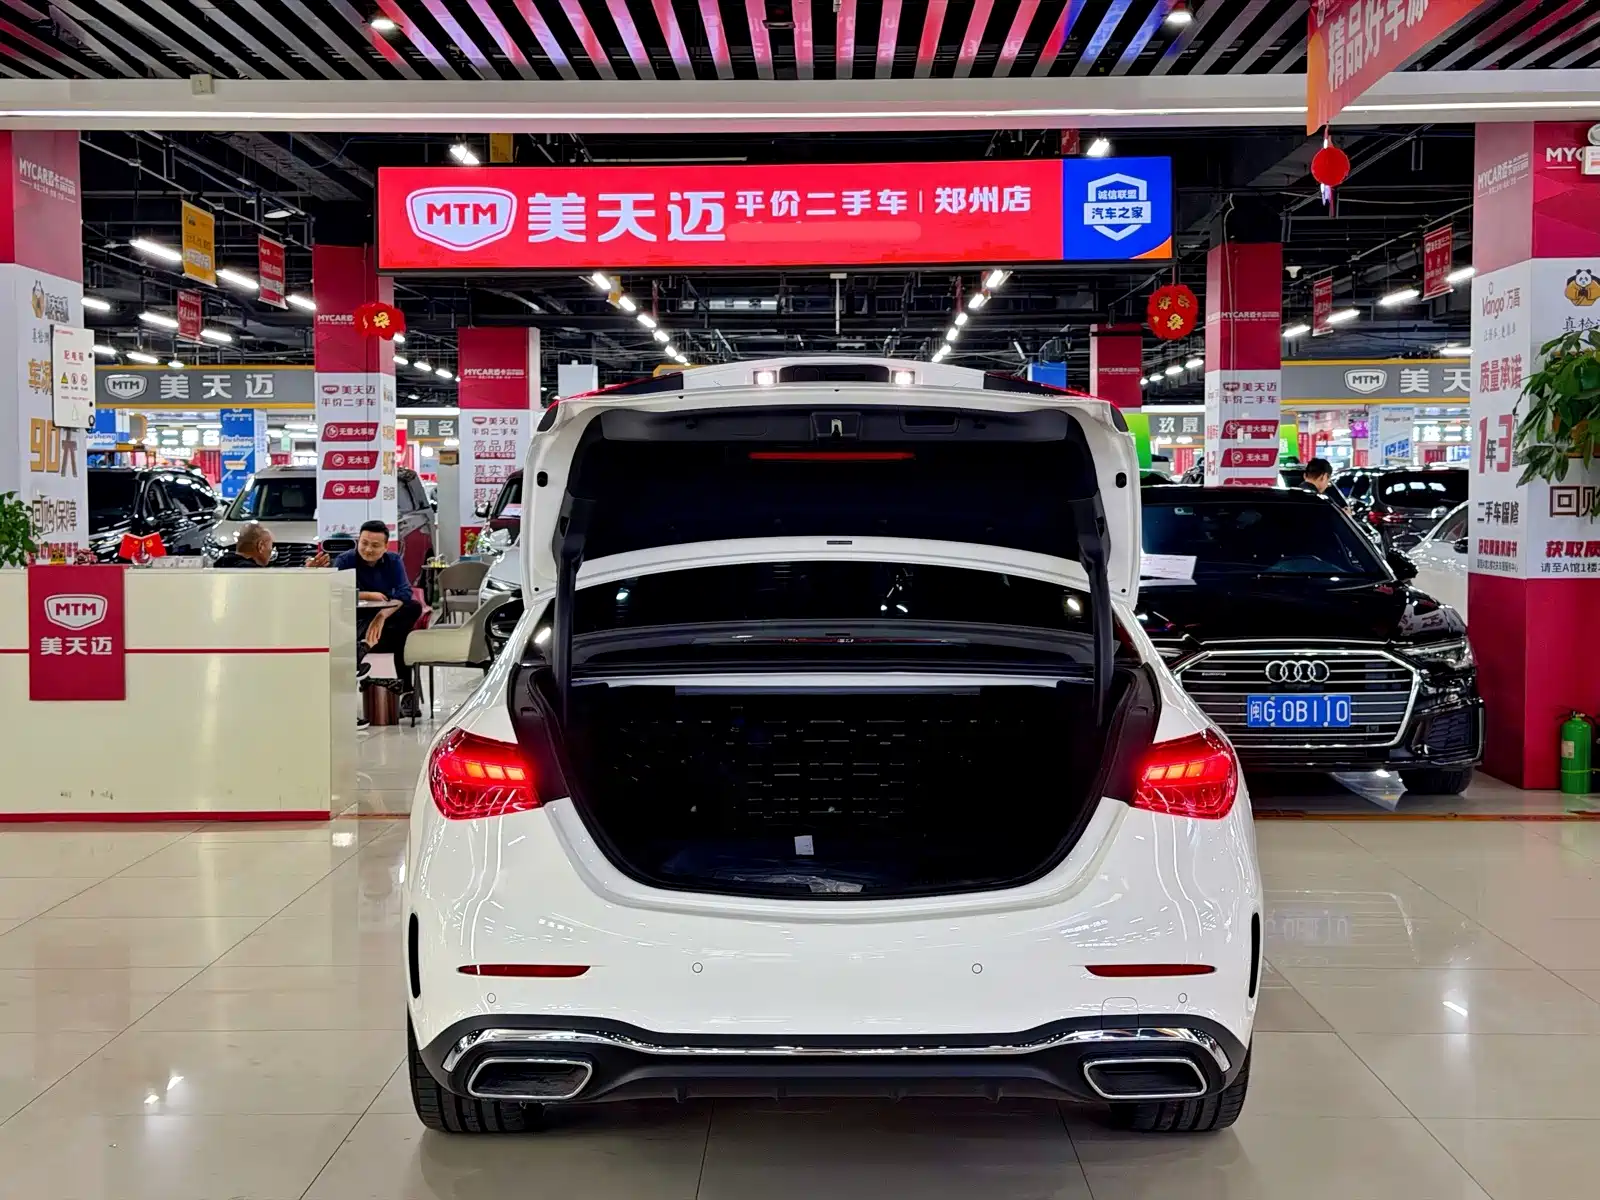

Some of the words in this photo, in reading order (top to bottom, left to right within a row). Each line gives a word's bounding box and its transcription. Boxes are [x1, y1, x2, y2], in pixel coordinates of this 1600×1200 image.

[1097, 190, 1137, 200] 诚信联盟
[426, 203, 497, 225] MTM
[528, 192, 725, 243] 美天迈
[735, 189, 907, 217] 平价二手车
[935, 186, 1031, 214] 郑州店
[1091, 206, 1143, 220] 汽车之家
[1482, 295, 1504, 319] Vango
[1563, 316, 1600, 332] 真检
[1352, 375, 1380, 385] MTM
[1480, 354, 1522, 393] 质量承诺
[112, 380, 140, 390] MTM
[160, 374, 274, 398] 美天迈
[342, 385, 376, 395] 美天迈
[1243, 382, 1277, 392] 美天迈
[32, 500, 77, 532] 回购保障
[1477, 501, 1519, 525] 二手车保修
[1541, 562, 1600, 573] 请至A馆1楼
[55, 603, 97, 616] MTM
[40, 636, 112, 655] 美天迈
